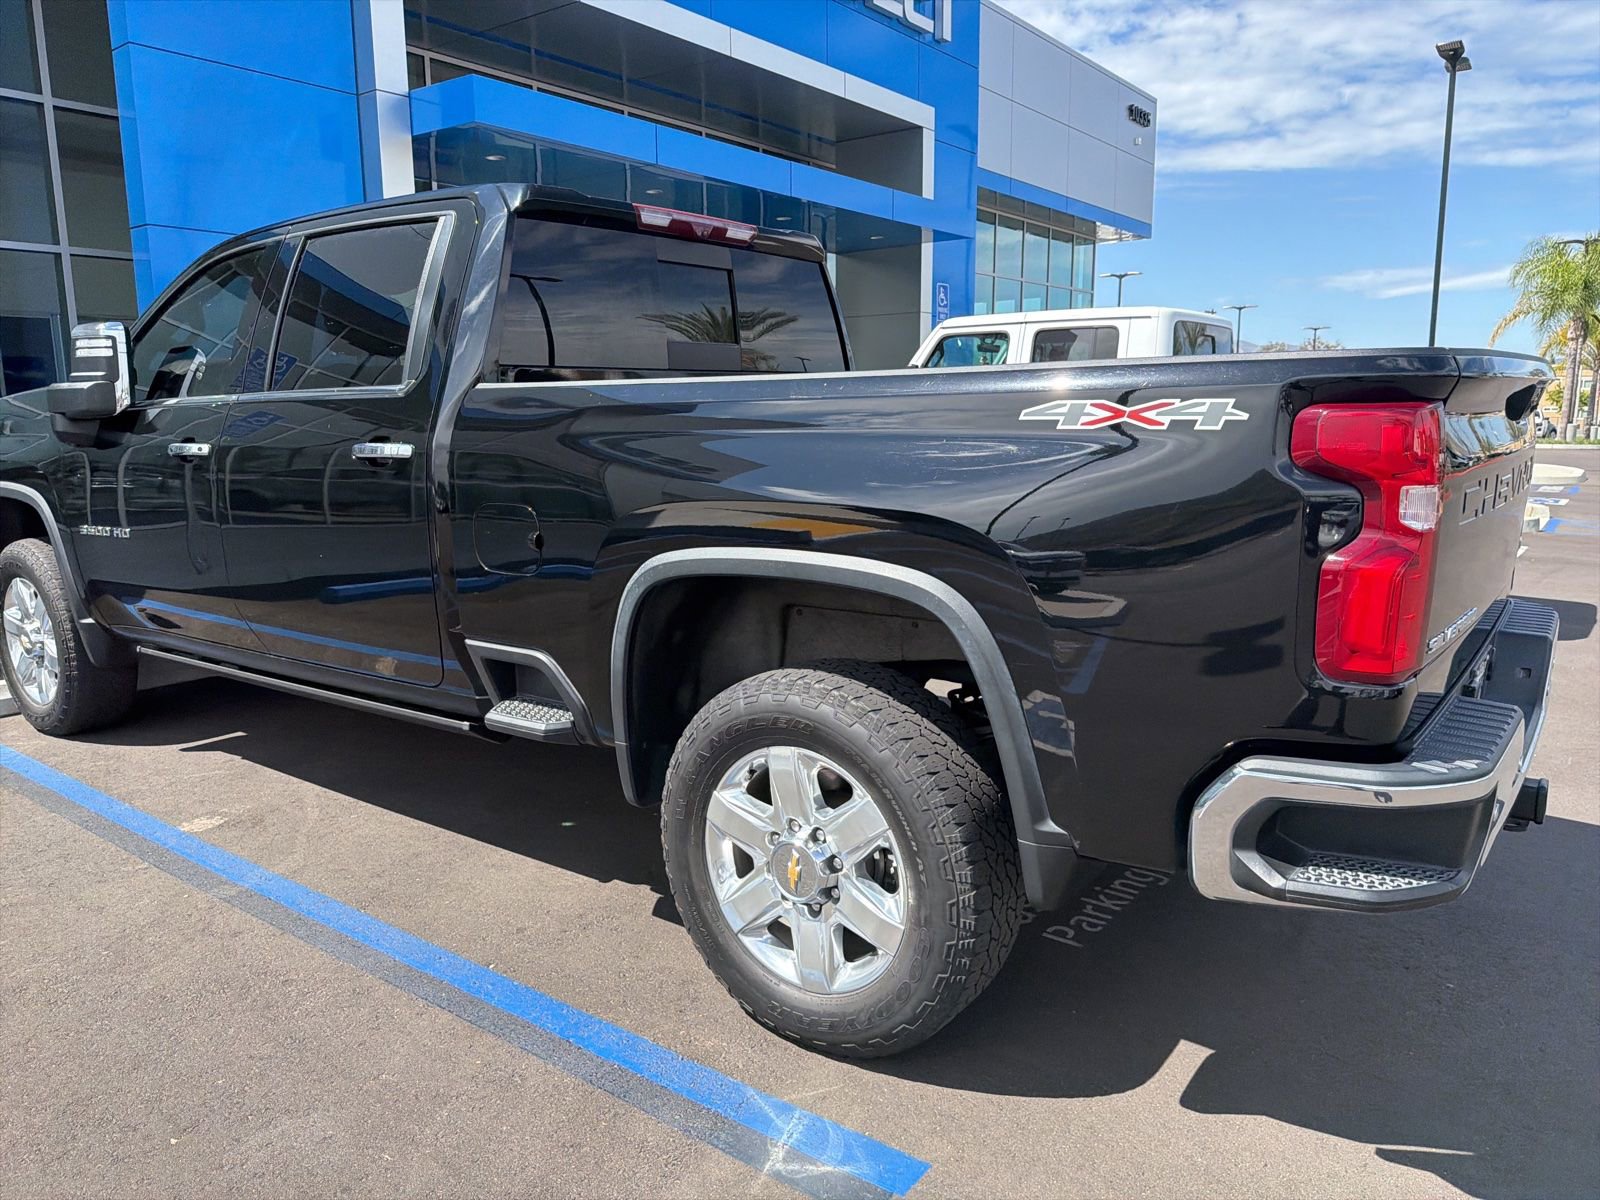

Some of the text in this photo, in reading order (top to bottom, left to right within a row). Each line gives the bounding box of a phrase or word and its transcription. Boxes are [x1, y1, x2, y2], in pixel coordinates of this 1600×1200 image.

[113, 527, 130, 538] HD
[1041, 867, 1171, 948] Parking
[767, 926, 931, 1033] GOODYEAR
